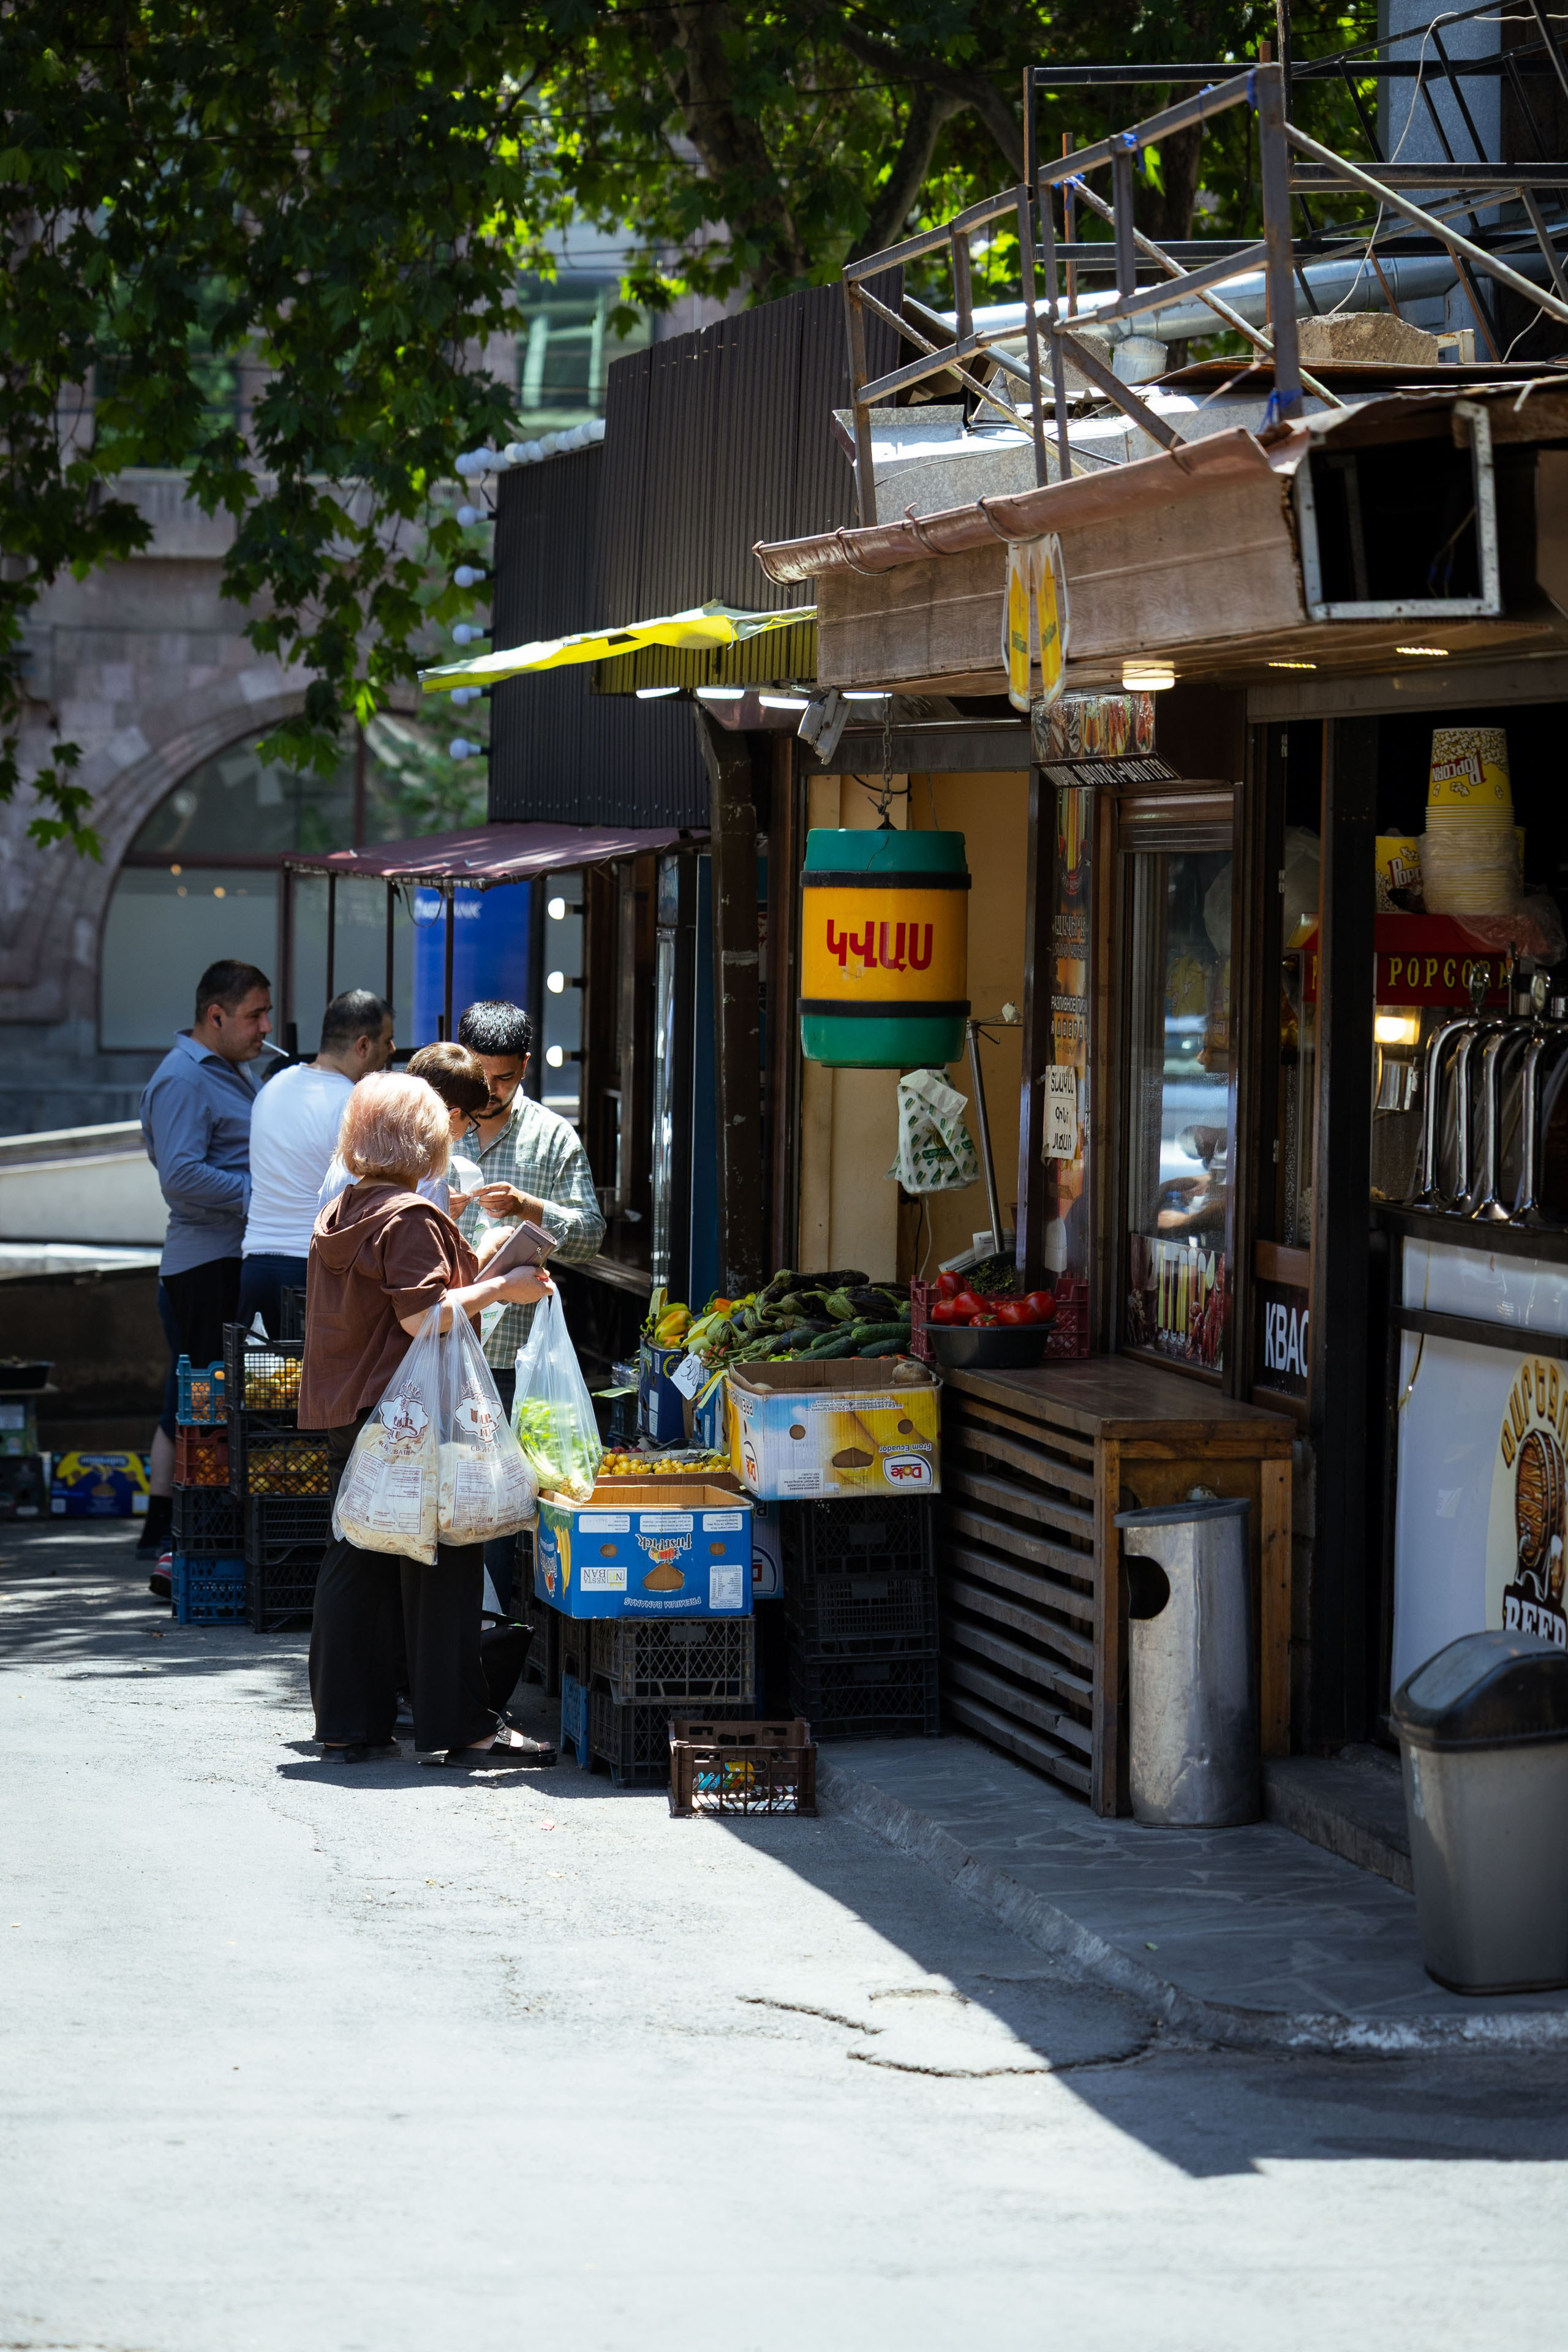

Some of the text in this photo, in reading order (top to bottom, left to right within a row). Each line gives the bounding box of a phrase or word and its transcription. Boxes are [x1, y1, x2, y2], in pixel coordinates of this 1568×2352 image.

[1432, 755, 1483, 786] POPCORN
[826, 919, 933, 972] ԿՎԱՍ
[1051, 995, 1076, 1012] РАЗЛИВНОЕ
[680, 1358, 699, 1386] 300
[891, 1466, 922, 1480] Dole
[583, 1569, 606, 1578] BAN
[624, 1596, 701, 1609] PREMIUM BANANAS
